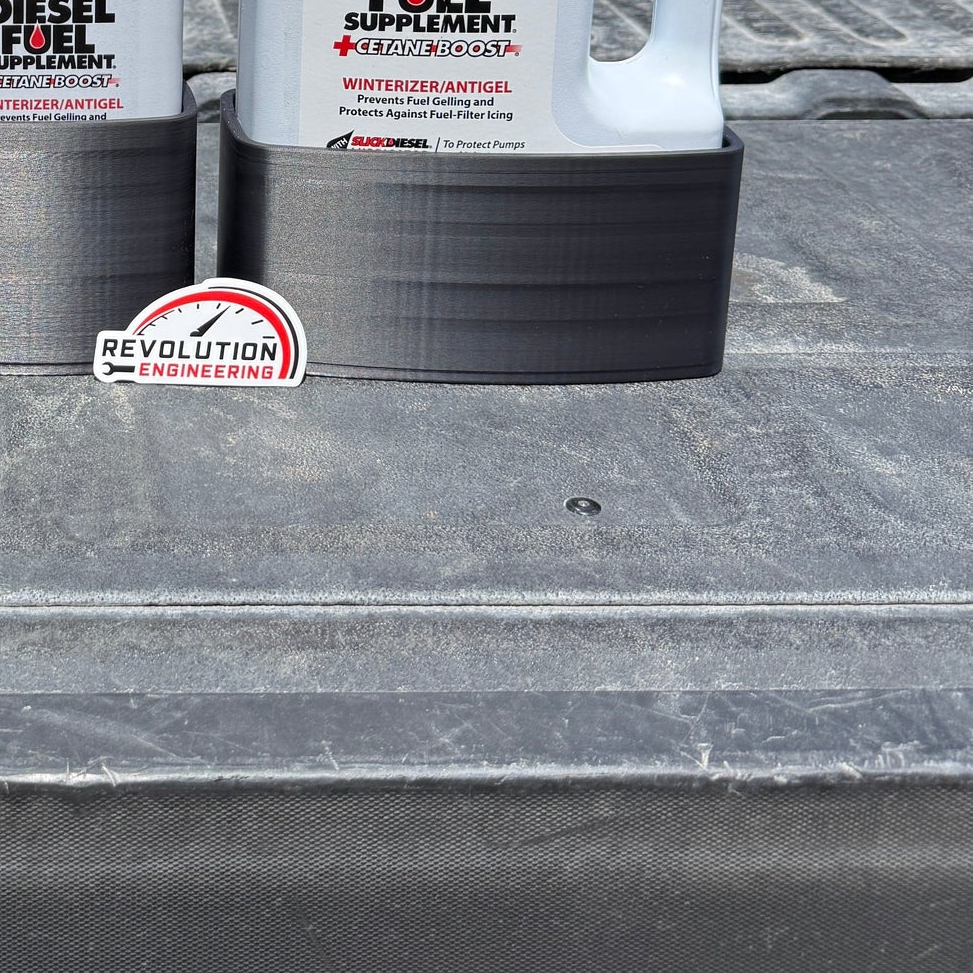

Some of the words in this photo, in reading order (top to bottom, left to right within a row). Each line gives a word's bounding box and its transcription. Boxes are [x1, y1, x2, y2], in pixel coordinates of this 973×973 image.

[343, 12, 517, 33] SUPPLEMENT
[1, 24, 96, 55] FUEL
[434, 39, 512, 58] BOOST
[52, 74, 112, 88] BOOST
[342, 77, 513, 94] WINTERIZER/ANTIGEL
[357, 94, 405, 106] Prevents
[407, 95, 430, 106] Fuel
[432, 96, 471, 109] Gelling
[473, 96, 495, 107] and
[32, 113, 52, 122] Fuel
[89, 112, 107, 121] and
[339, 106, 384, 118] Protects
[385, 107, 428, 121] Against
[429, 109, 485, 121] Fuel-Filter
[486, 109, 513, 122] Icing
[443, 139, 454, 149] To
[456, 139, 491, 150] Protect
[492, 140, 526, 152] Pumps
[101, 338, 278, 362] REVOLUTION
[138, 362, 274, 380] ENGINEERING
